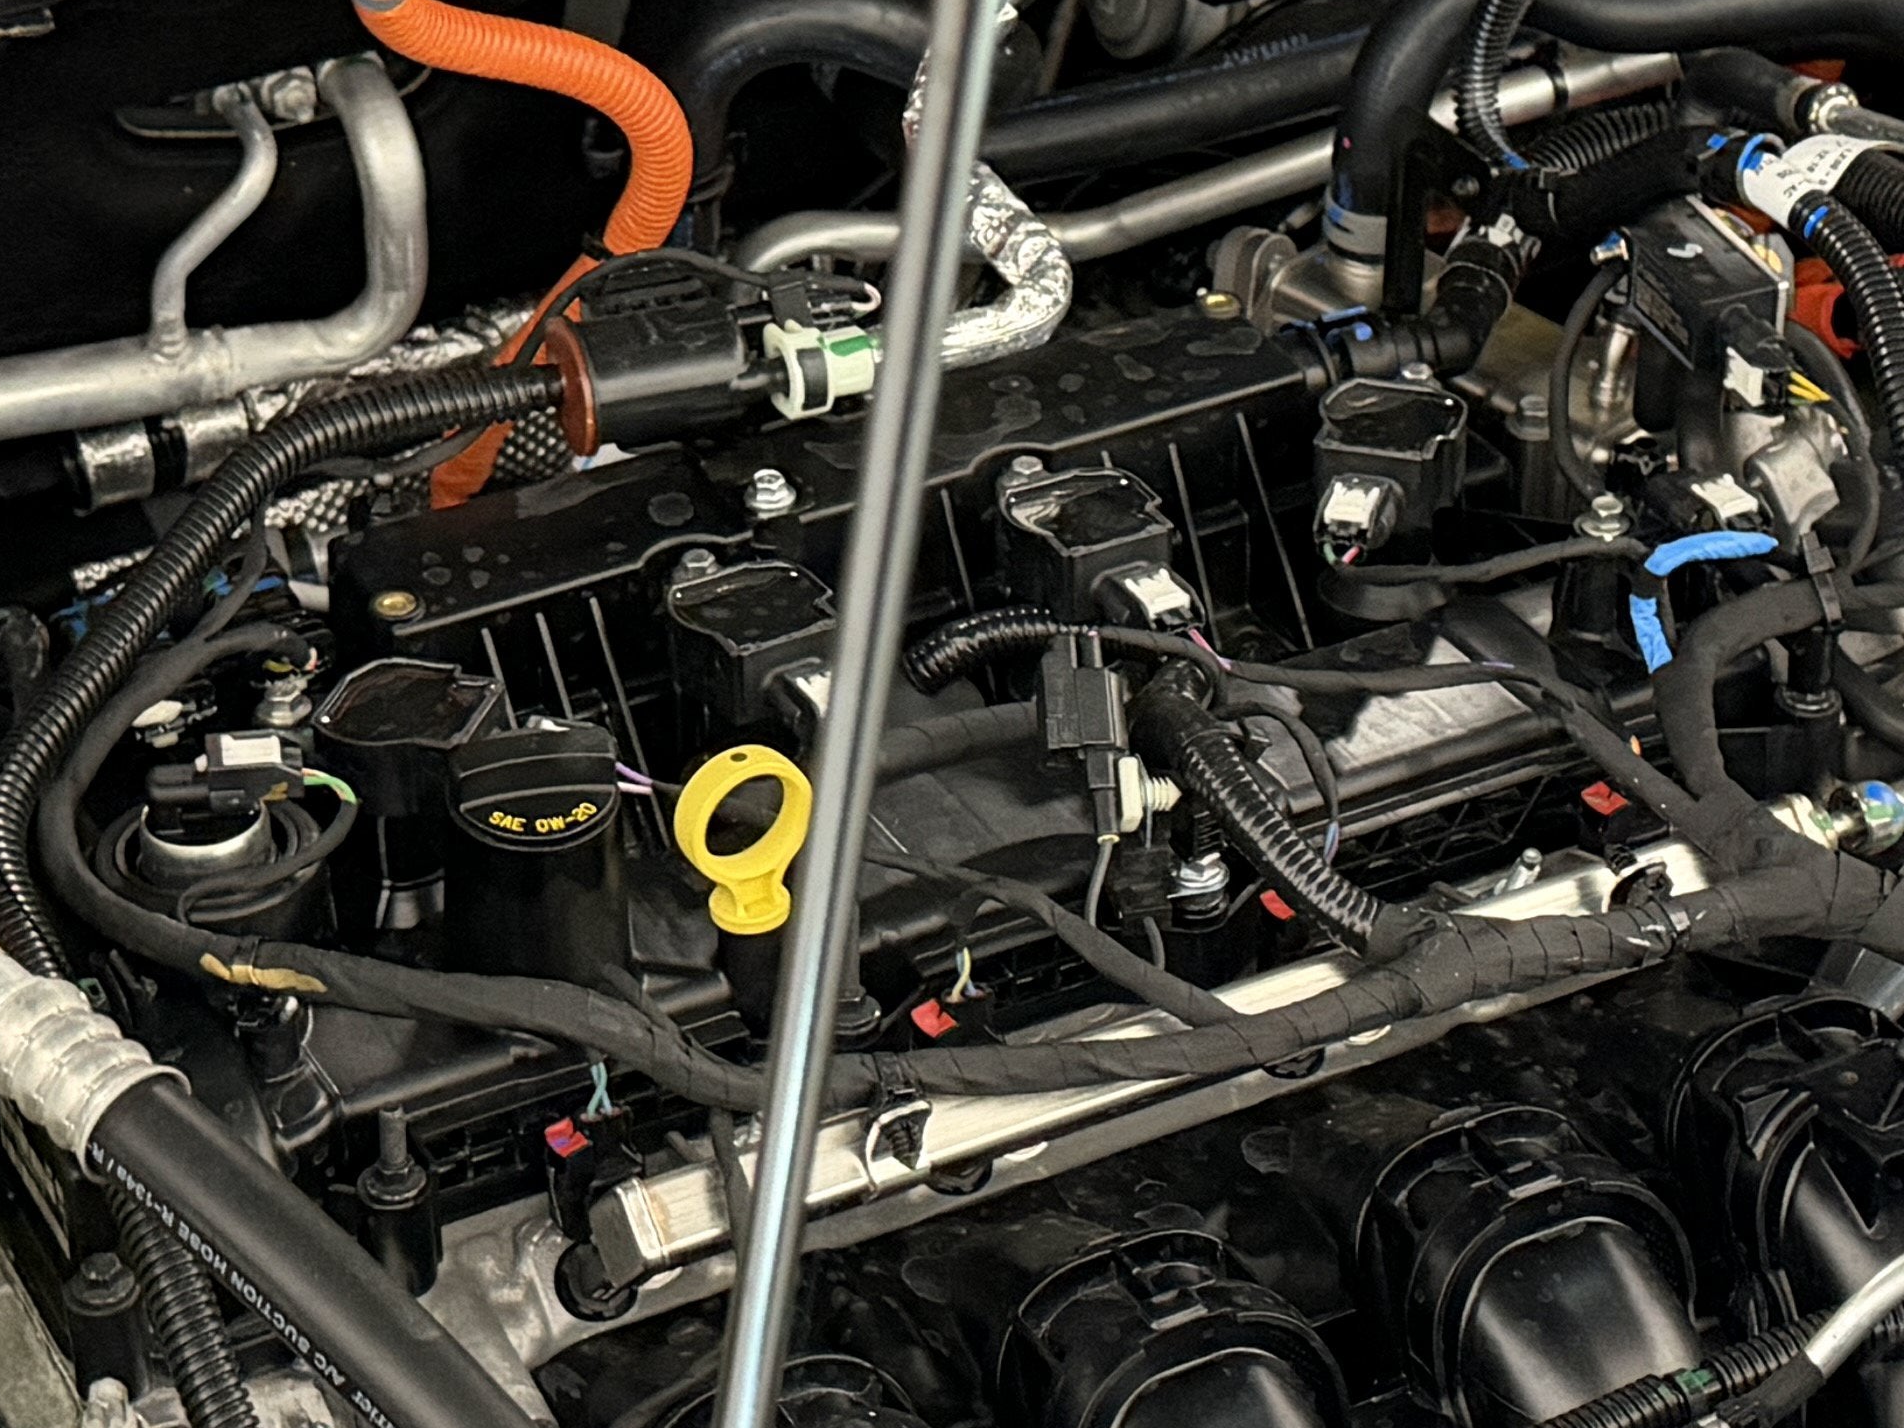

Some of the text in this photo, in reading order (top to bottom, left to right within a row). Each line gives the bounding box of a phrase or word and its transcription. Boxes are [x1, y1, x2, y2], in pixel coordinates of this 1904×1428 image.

[489, 803, 597, 833] SAE 0W-20
[117, 1166, 173, 1226] R-134a
[179, 1221, 226, 1274] HOSE
[231, 1271, 310, 1353] SUCTION
[315, 1352, 345, 1385] A/C
